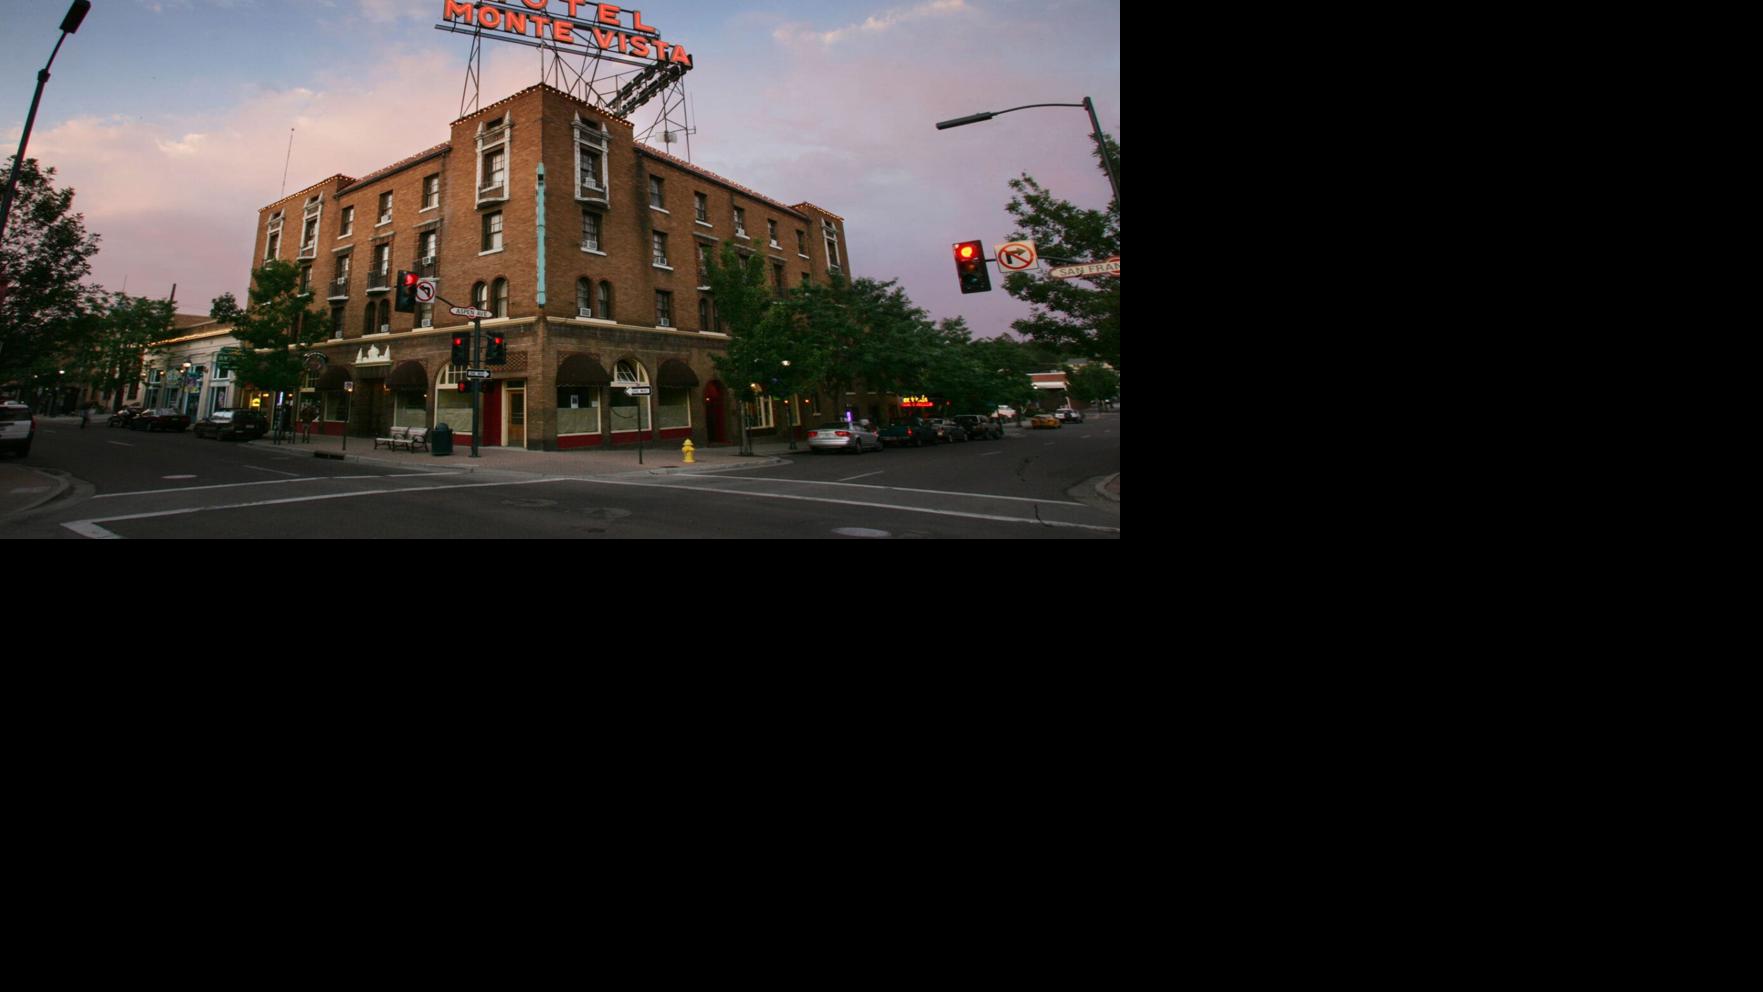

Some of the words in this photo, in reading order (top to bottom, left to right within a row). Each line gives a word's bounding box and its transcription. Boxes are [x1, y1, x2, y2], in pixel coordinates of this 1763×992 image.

[443, 0, 575, 44] MONTE
[592, 26, 691, 66] VISTA
[1059, 267, 1085, 275] SAN
